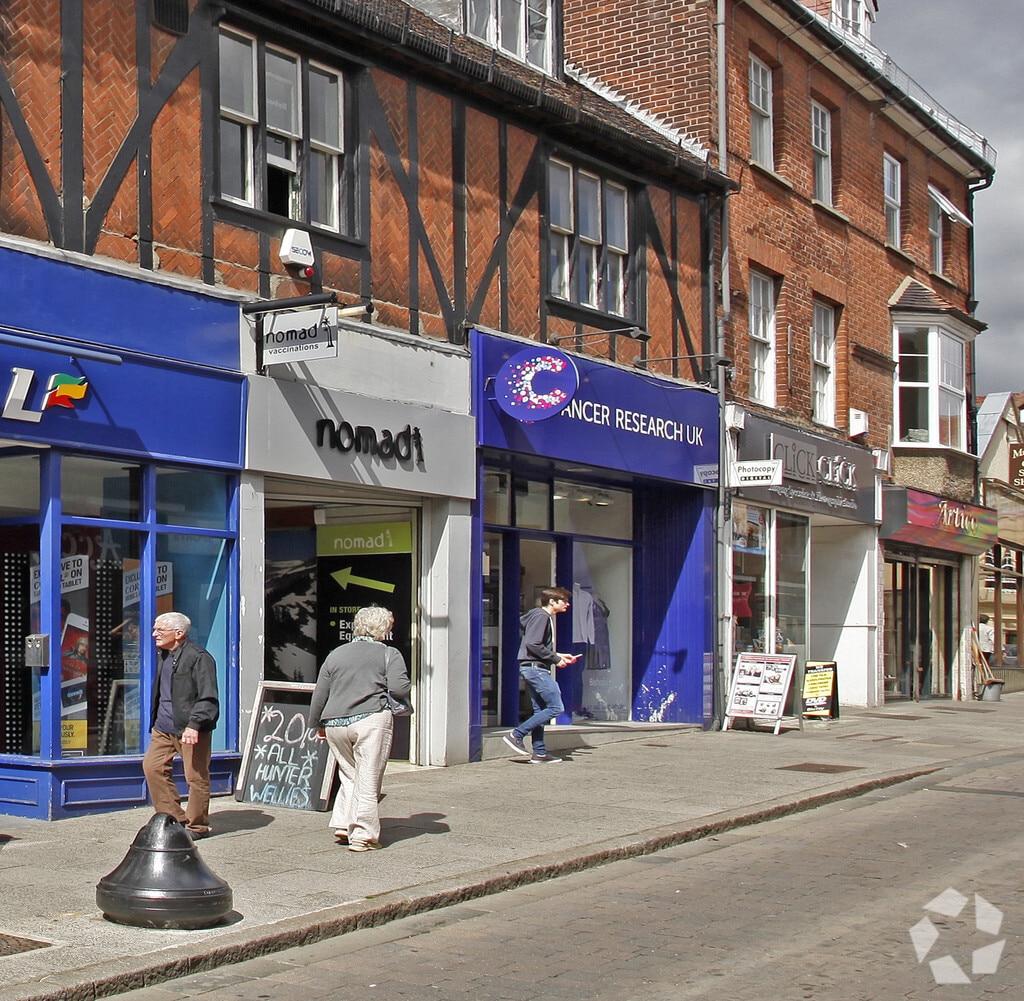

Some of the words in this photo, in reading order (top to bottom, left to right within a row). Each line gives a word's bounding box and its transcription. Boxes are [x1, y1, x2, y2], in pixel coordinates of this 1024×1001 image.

[291, 246, 311, 257] SECOM
[266, 322, 318, 344] nomad
[268, 343, 319, 355] vaccinations
[615, 408, 683, 443] RESEARCH
[686, 424, 704, 447] UK
[316, 418, 413, 461] nomad
[737, 465, 775, 474] Photocopy
[334, 533, 385, 550] nomad
[72, 558, 83, 568] TO
[70, 568, 83, 579] ON
[158, 564, 168, 575] TO
[62, 578, 83, 589] TABLET
[156, 574, 168, 584] ON
[267, 743, 298, 767] ALL
[255, 763, 313, 787] HUNTER
[250, 783, 312, 807] WELLIES
